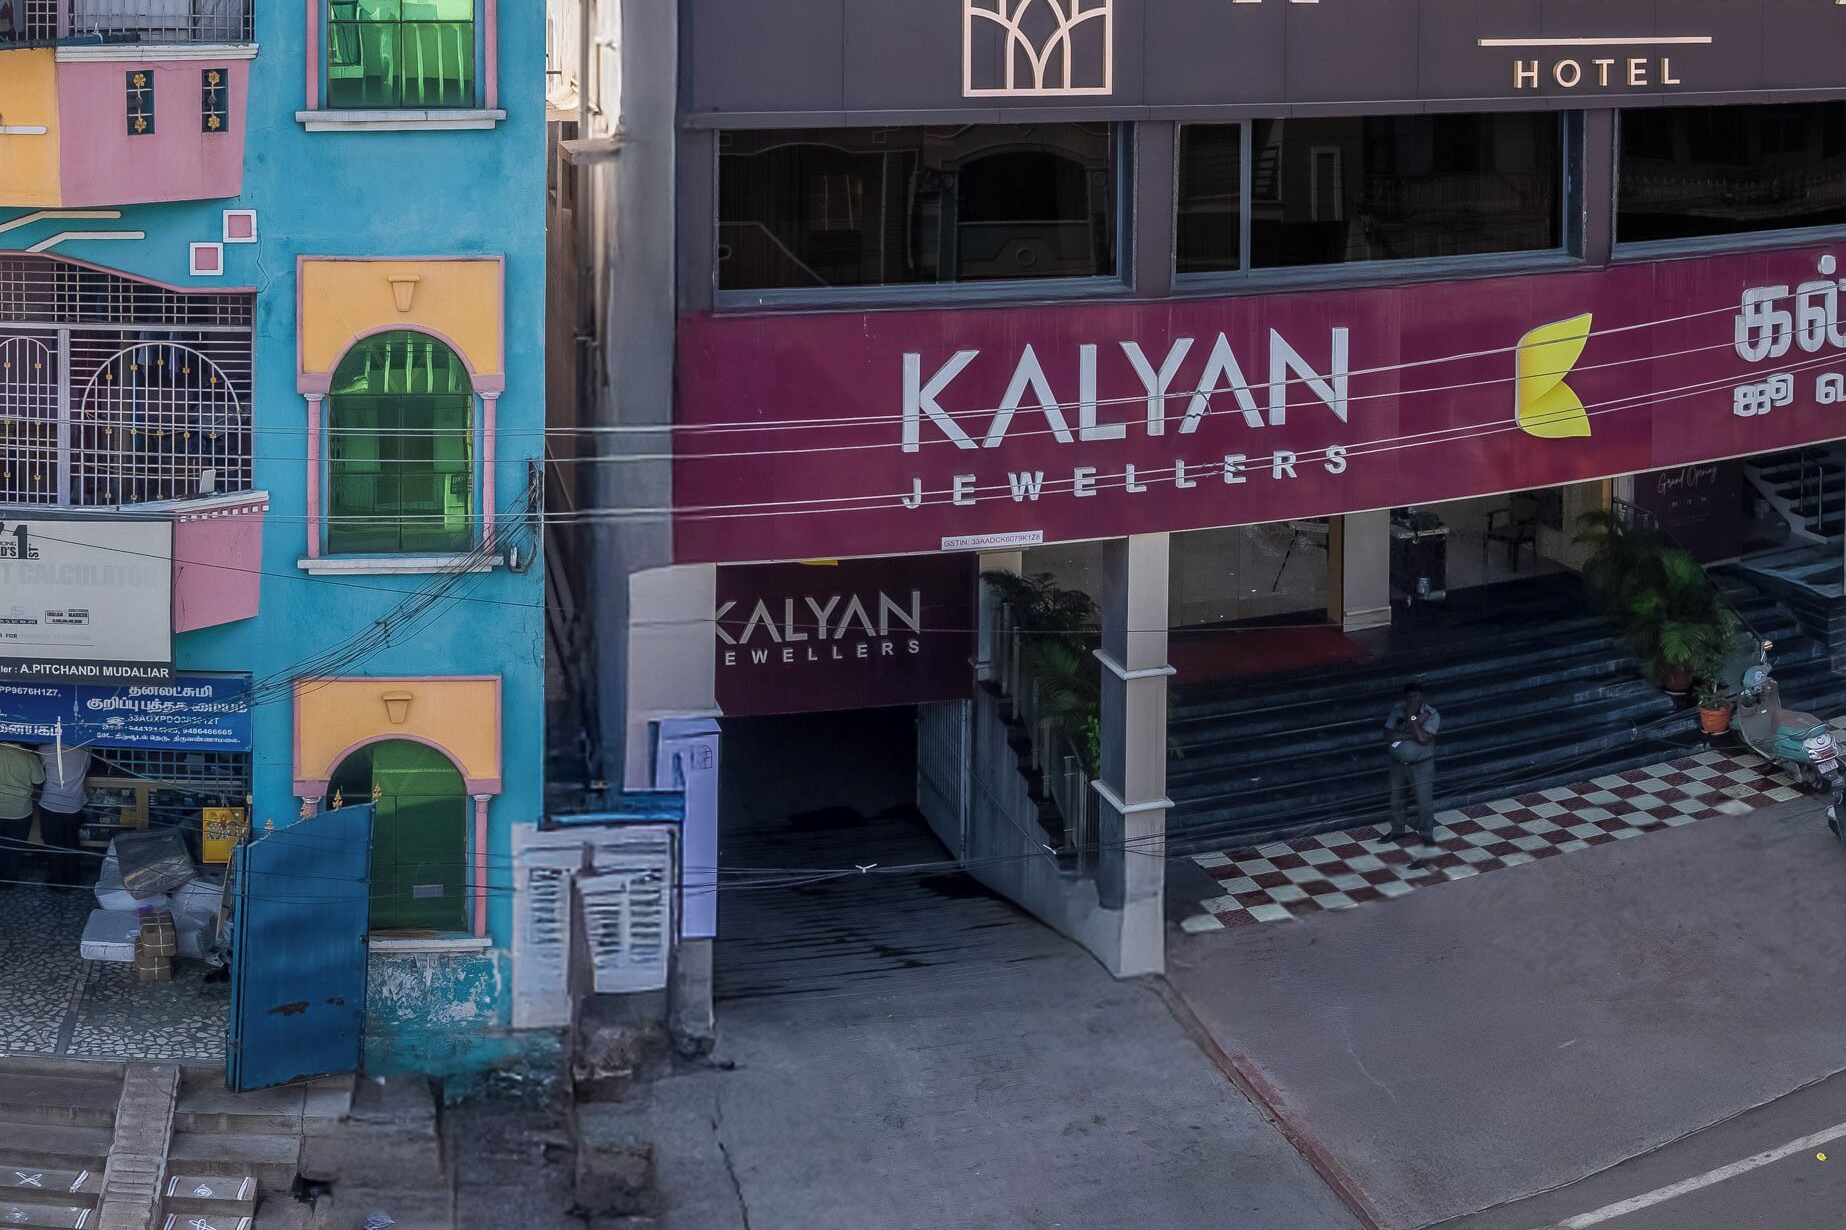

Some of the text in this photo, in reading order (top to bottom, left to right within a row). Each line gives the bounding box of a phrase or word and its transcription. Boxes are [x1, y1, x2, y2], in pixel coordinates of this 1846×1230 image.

[1513, 57, 1681, 89] HOTEL
[902, 327, 1349, 453] KALYAN
[902, 446, 1347, 510] JEWELLERS
[725, 639, 920, 666] EWELLERS
[19, 663, 100, 677] A.PITCHANDI
[103, 665, 169, 678] MUDALIAR
[128, 684, 213, 698] தனலட்சுமி
